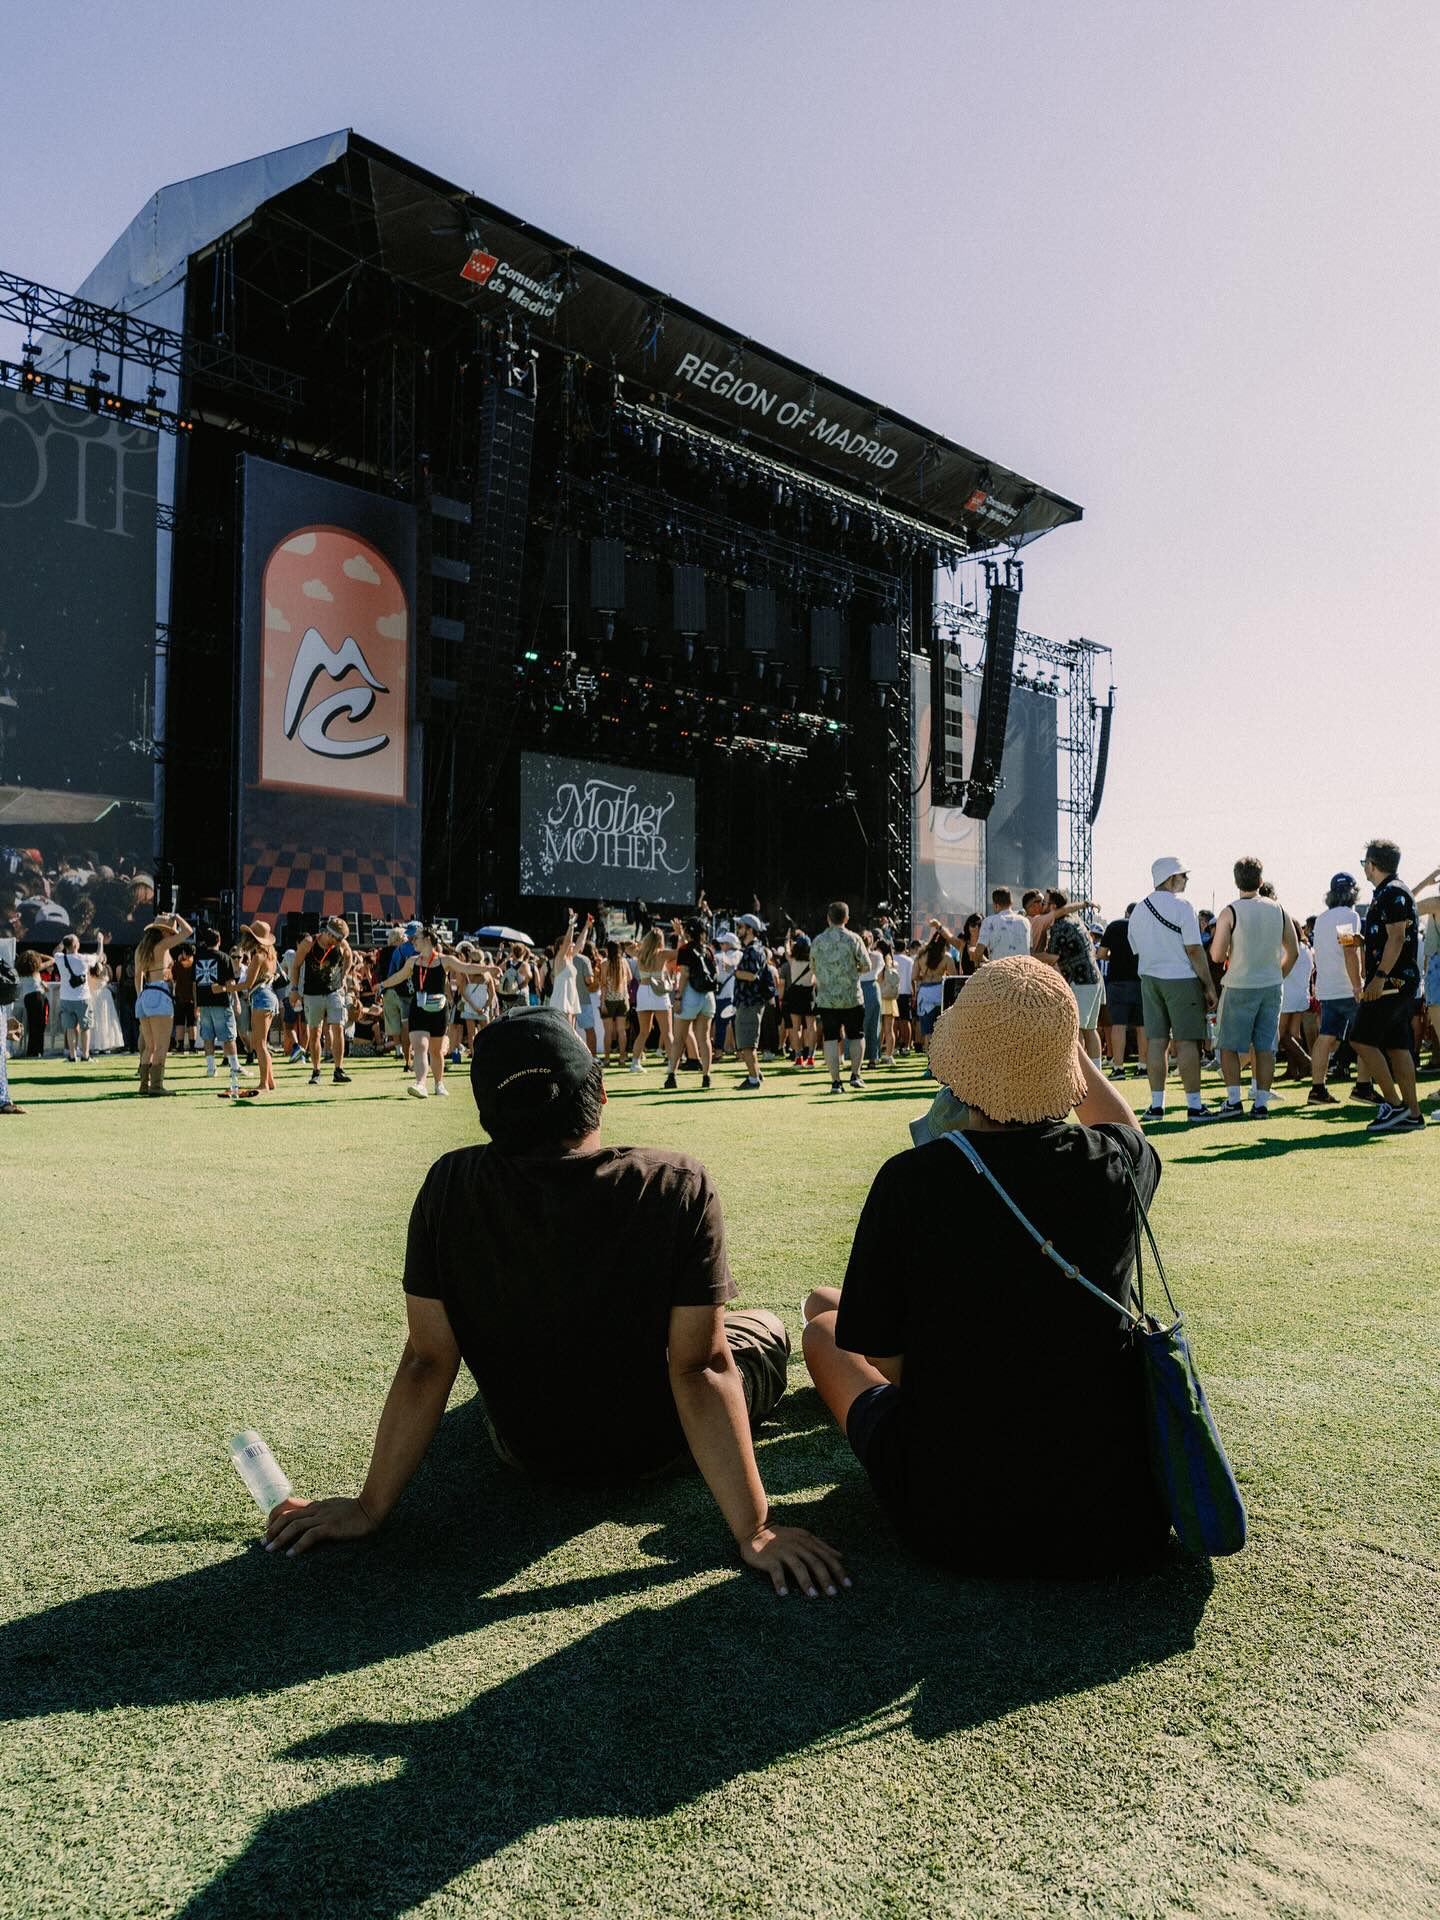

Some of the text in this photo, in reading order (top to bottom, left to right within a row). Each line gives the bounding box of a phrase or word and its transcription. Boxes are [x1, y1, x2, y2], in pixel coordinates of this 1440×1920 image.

[488, 279, 556, 317] de Madrid
[497, 262, 563, 303] Comunidd
[675, 353, 899, 469] REGION OF MADRID
[548, 779, 675, 836] Mother
[542, 826, 690, 874] MOTHER
